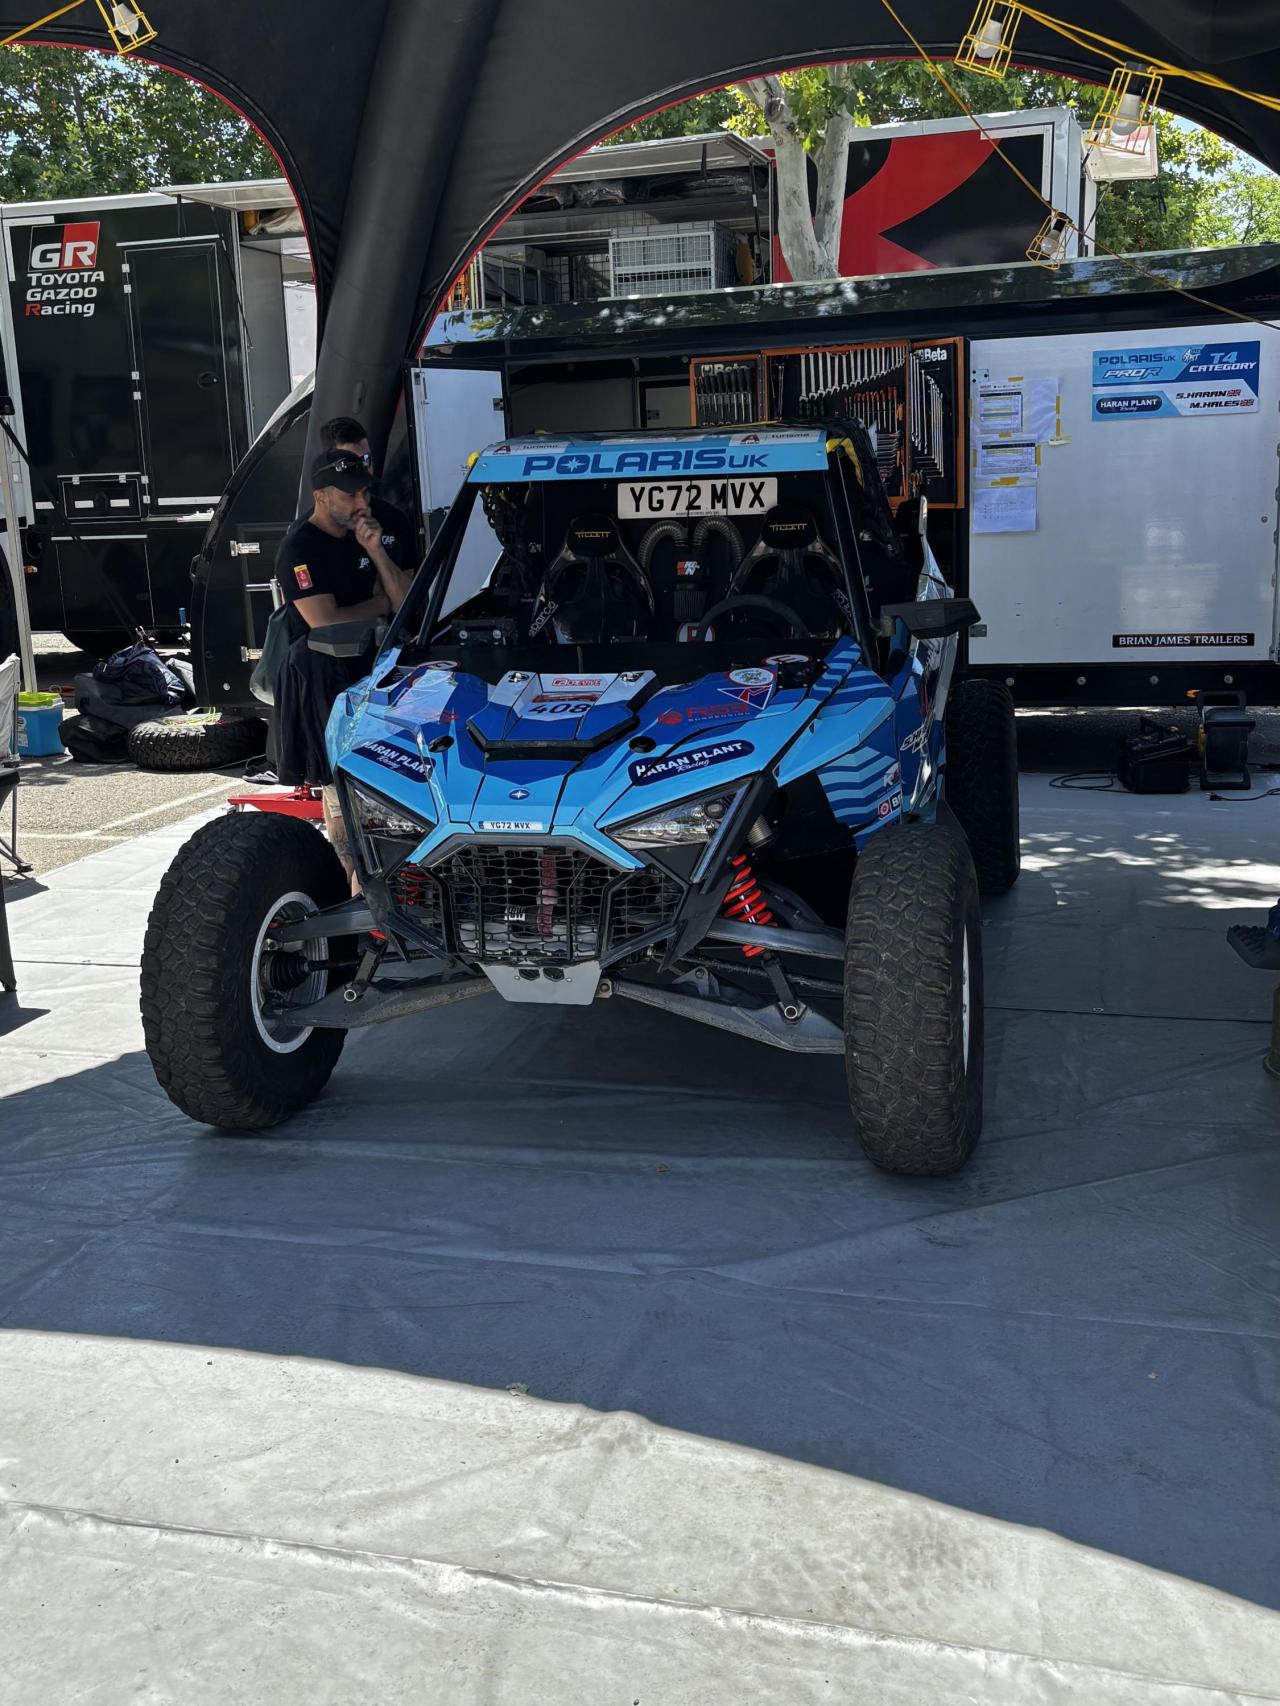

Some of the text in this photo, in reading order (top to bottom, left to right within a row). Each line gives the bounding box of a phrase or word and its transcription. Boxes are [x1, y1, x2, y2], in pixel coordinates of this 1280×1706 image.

[31, 241, 95, 269] GR
[27, 271, 104, 286] TOYOTA
[26, 287, 97, 301] GAZOO
[25, 301, 95, 317] Racing
[924, 347, 947, 362] Beta
[1099, 353, 1163, 366] POLARIS
[1210, 351, 1238, 364] T4
[714, 362, 749, 376] Bet
[1189, 361, 1257, 373] CATEGORY
[1100, 398, 1158, 408] HARAN PLANT
[522, 448, 769, 476] POLARIS UK
[629, 481, 766, 512] YG72 MVX
[528, 601, 559, 636] sparco
[1119, 635, 1248, 646] BRIAN JAMES TRAILERS
[528, 703, 591, 714] 408
[692, 741, 743, 761] PLANT
[490, 821, 530, 829] YG72 MVX
